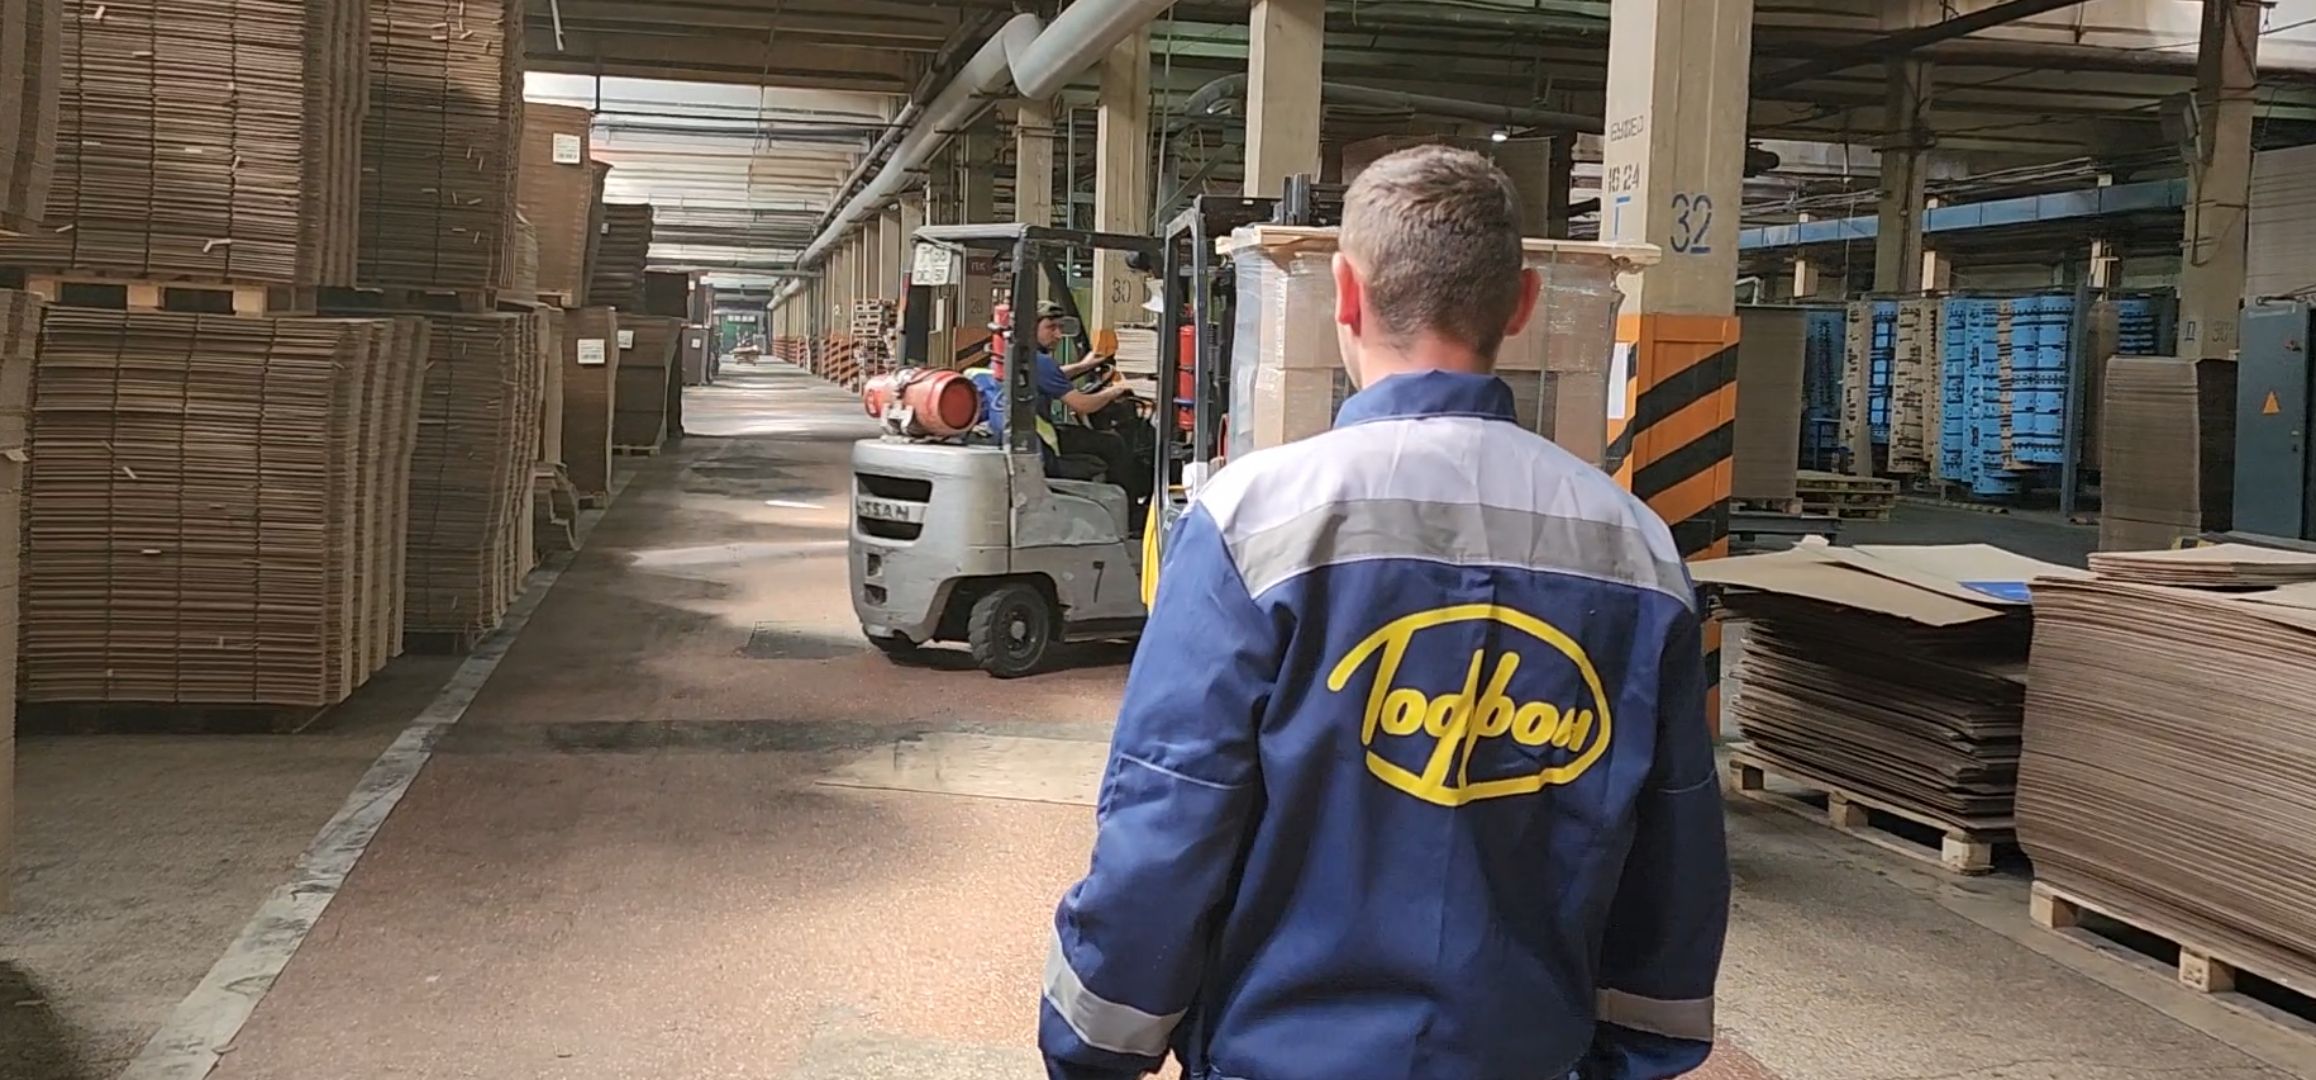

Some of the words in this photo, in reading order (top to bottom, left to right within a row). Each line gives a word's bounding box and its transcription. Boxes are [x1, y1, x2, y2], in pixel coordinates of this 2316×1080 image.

[1623, 162, 1640, 191] 24
[1671, 193, 1712, 253] 32
[1111, 278, 1131, 303] 30
[856, 500, 910, 521] SSAN
[1092, 560, 1105, 603] 7
